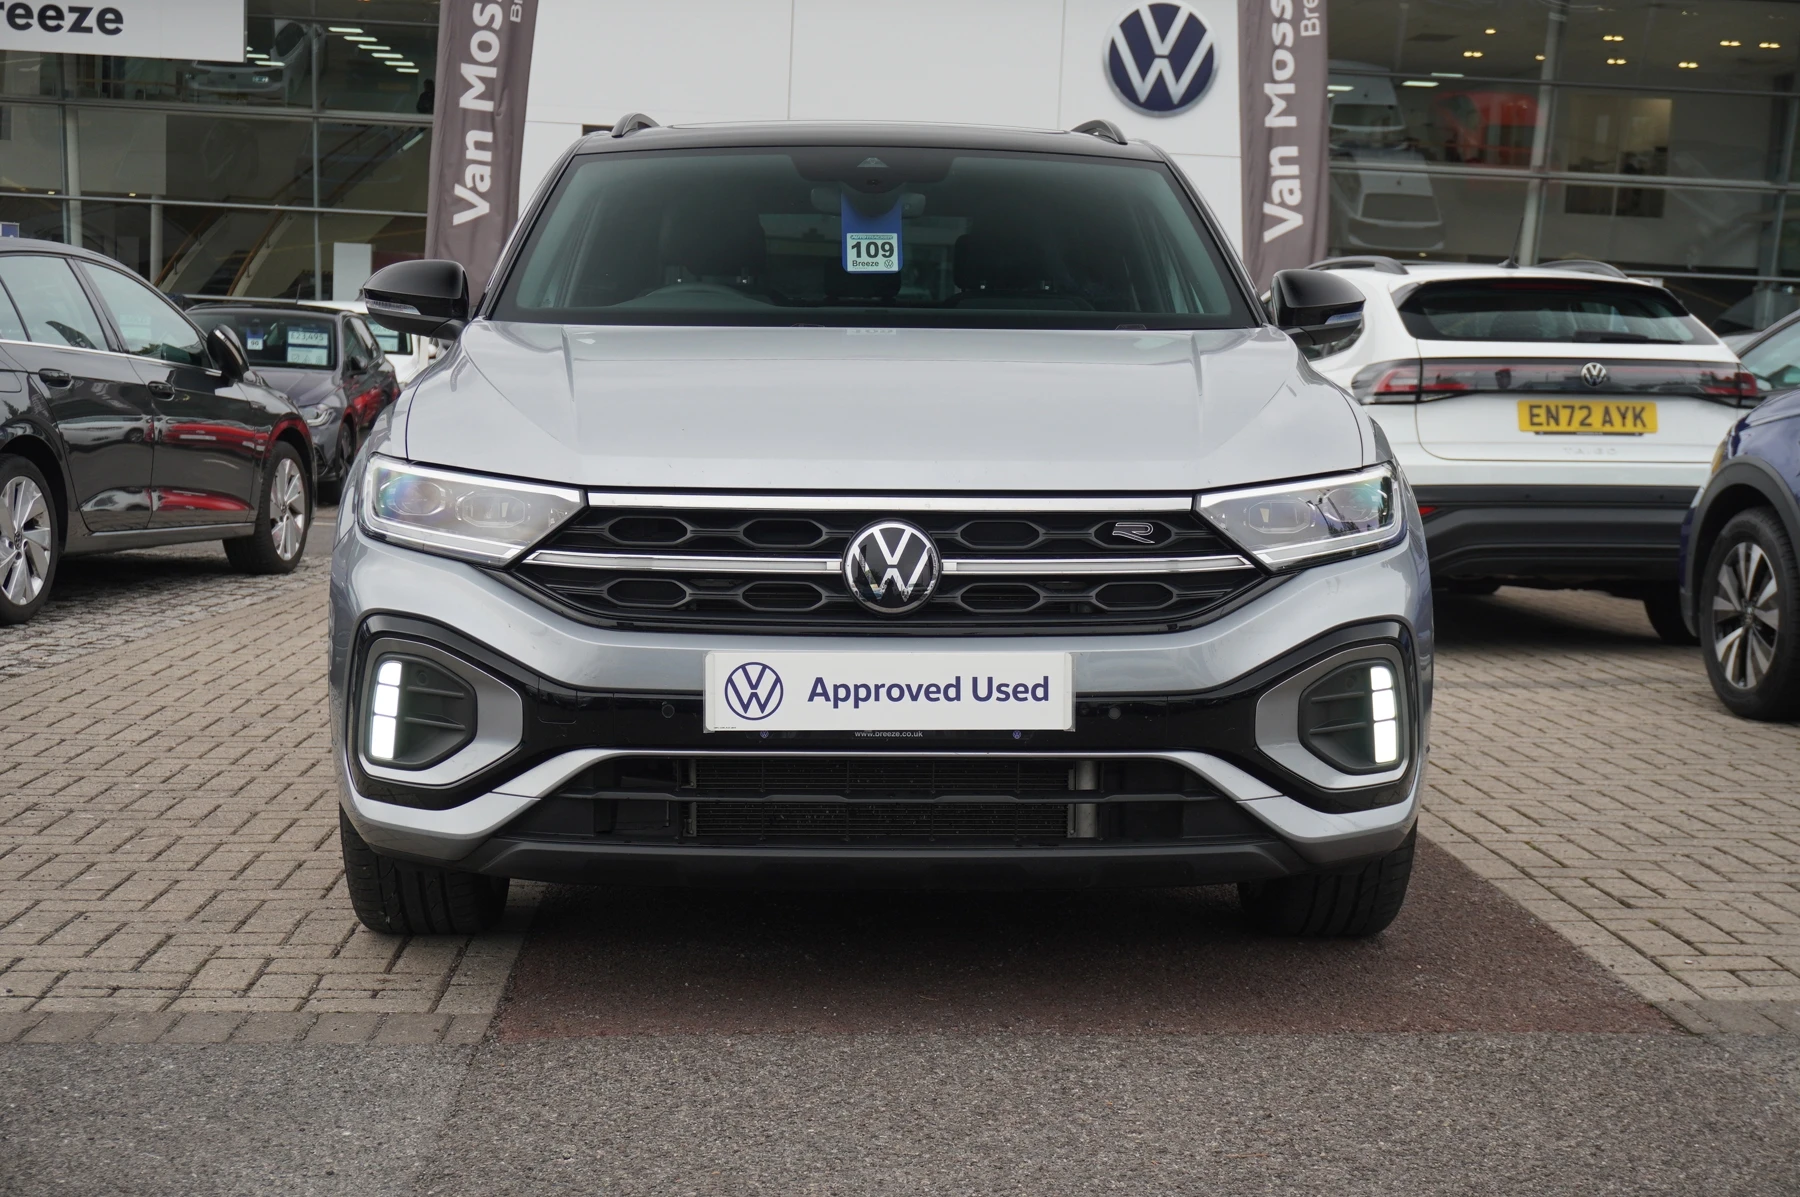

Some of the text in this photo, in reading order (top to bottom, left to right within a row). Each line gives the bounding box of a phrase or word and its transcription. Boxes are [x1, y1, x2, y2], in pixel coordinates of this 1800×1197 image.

[453, 0, 503, 226] Van Mos
[1263, 0, 1304, 243] Van Moss
[851, 241, 894, 258] 109
[1528, 404, 1647, 428] EN72 AYK
[807, 676, 962, 709] Approved
[971, 676, 1049, 702] Used
